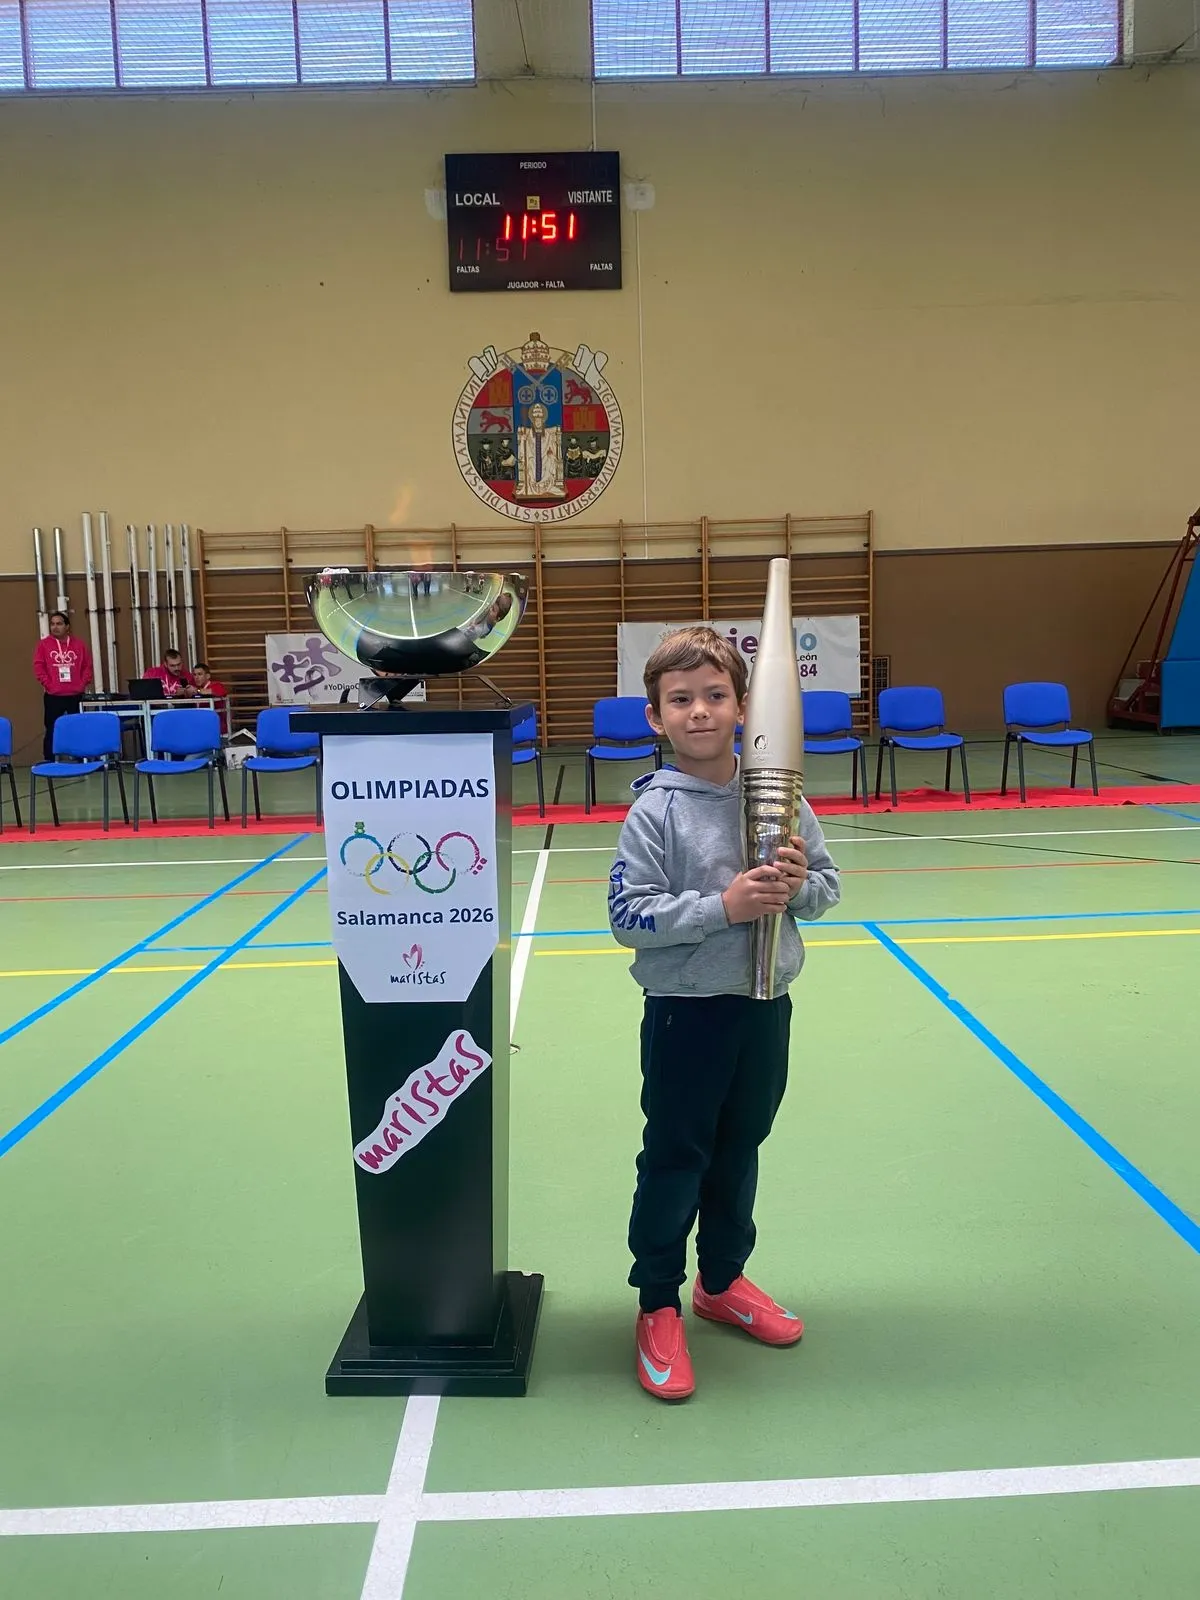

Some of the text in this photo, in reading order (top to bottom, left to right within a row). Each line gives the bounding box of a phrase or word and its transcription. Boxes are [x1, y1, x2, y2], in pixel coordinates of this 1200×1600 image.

[455, 193, 500, 206] LOCAL
[567, 190, 613, 204] VISITANTE
[505, 213, 576, 240] 11:51
[589, 263, 613, 271] FALTAS
[507, 281, 539, 289] JUGADOR
[545, 281, 565, 289] FALTA
[796, 652, 818, 662] eón
[331, 778, 489, 800] OLIMPIADAS
[337, 908, 494, 926] Salamanca 2026
[390, 970, 447, 985] maristas
[358, 1033, 484, 1170] maristas
